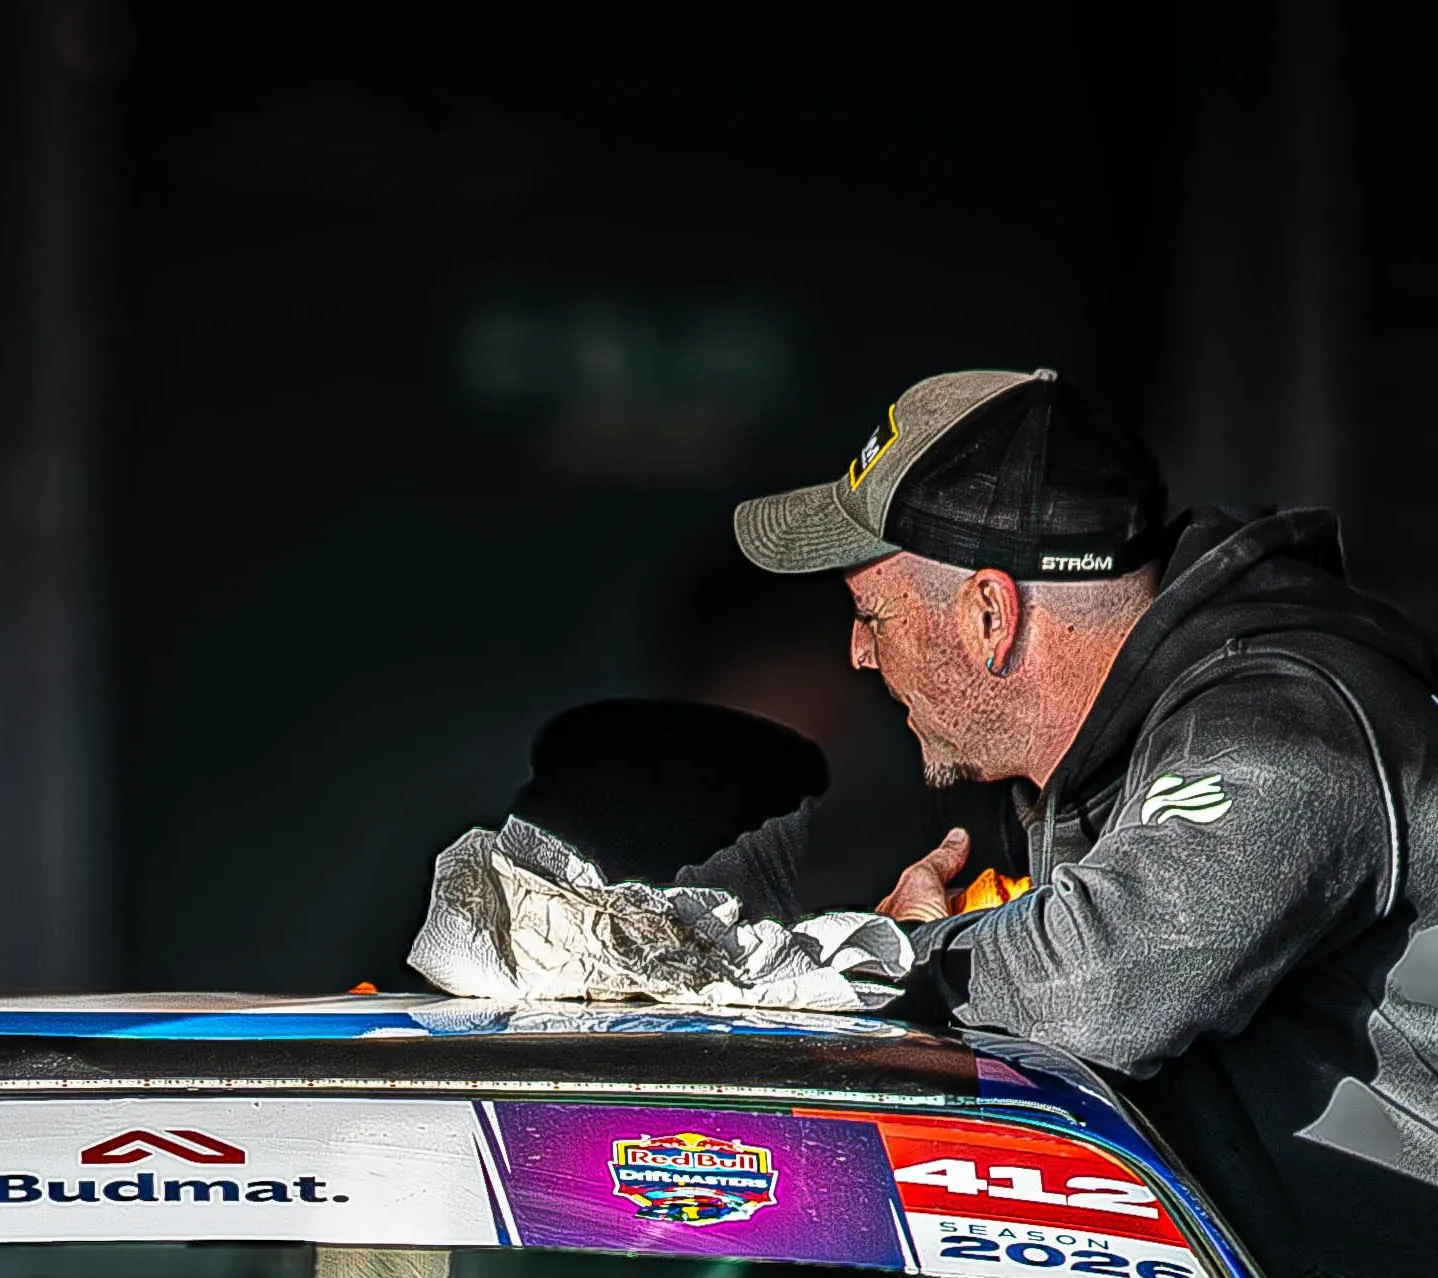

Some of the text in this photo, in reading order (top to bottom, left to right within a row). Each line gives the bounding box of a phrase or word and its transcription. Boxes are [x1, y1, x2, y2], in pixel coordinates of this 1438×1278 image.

[1041, 551, 1113, 572] STRÖM
[630, 1150, 755, 1170] Red Bull
[673, 1174, 769, 1189] MASTERS
[893, 1157, 1160, 1220] 412
[939, 1221, 1109, 1250] SEASON
